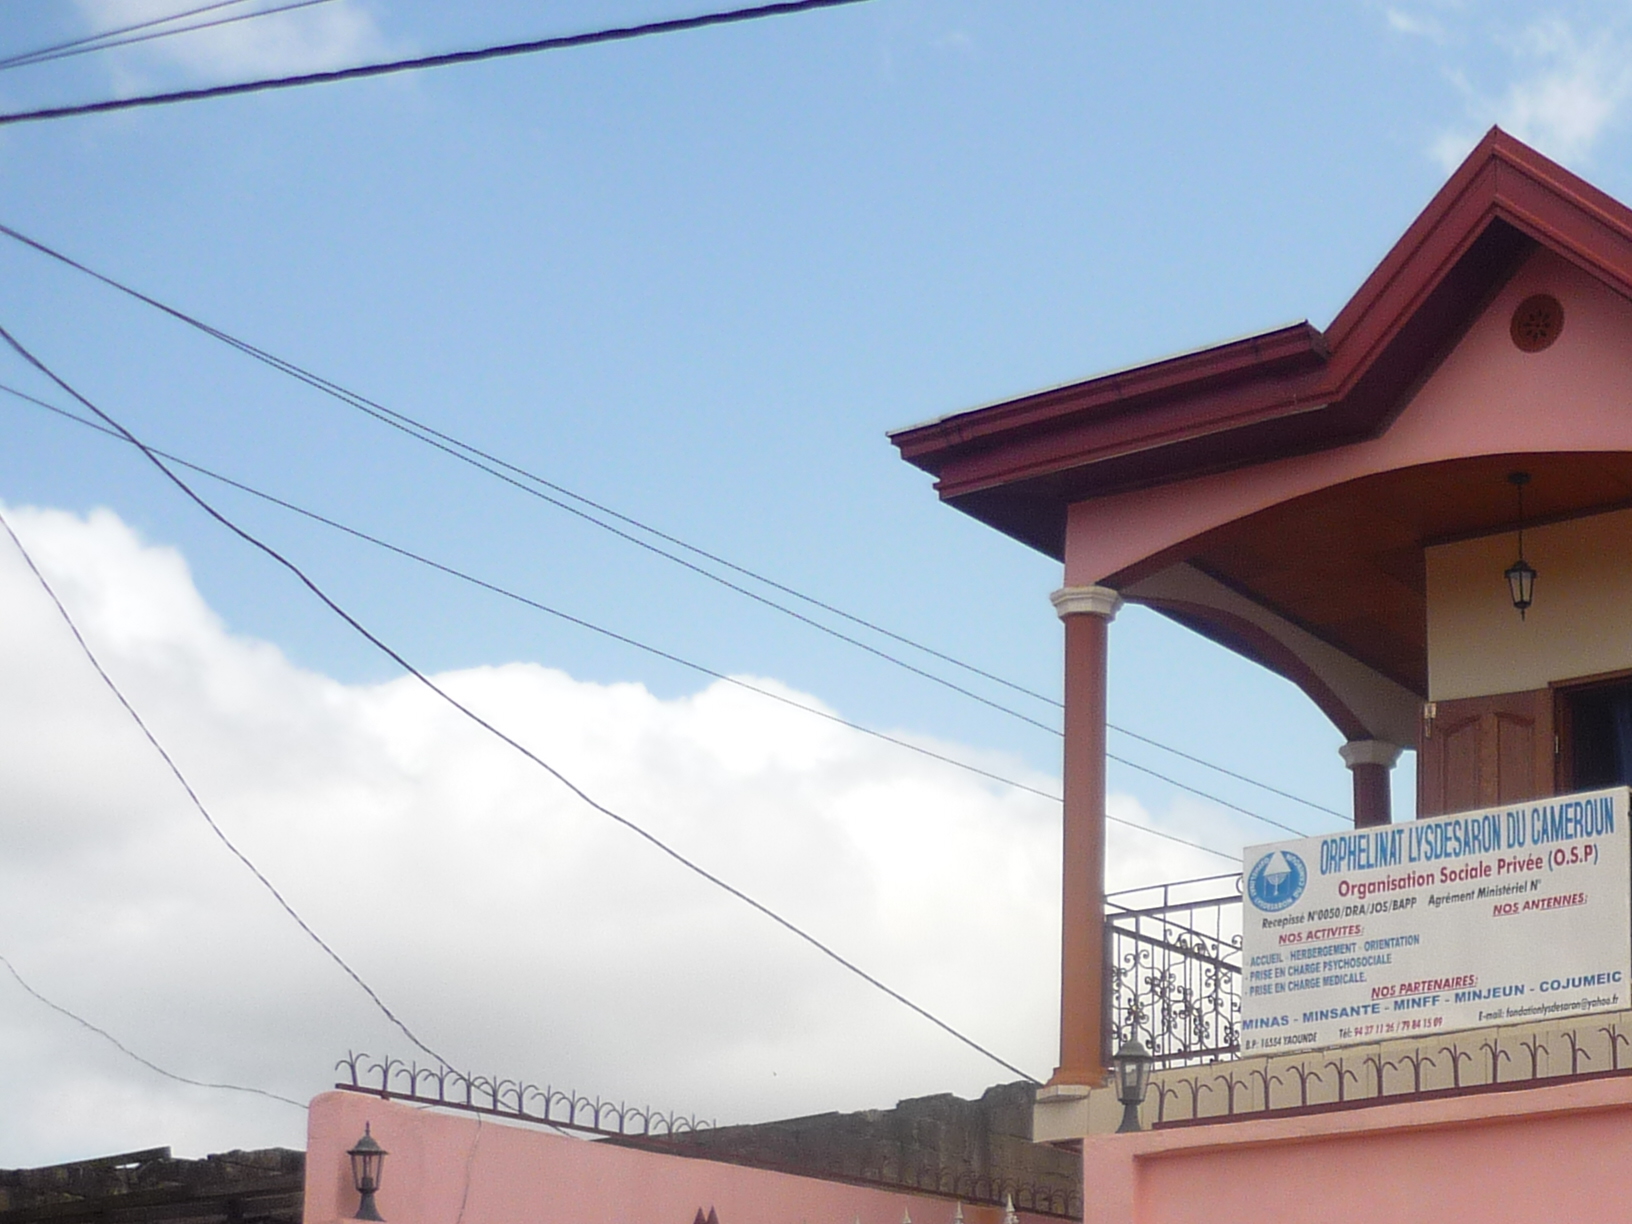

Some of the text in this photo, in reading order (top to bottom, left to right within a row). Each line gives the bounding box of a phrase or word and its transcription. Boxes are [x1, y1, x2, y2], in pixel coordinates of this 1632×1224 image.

[1320, 797, 1614, 875] ORPHELINAT LYSDESARON DU CAMEROUN
[1338, 844, 1599, 899] Organisation Sociale Privée (O.S.P)
[1427, 890, 1475, 907] Agrément
[1477, 881, 1527, 899] Ministériel
[1493, 902, 1520, 916] NOS
[1250, 953, 1283, 967] ACCUEIL
[1364, 934, 1420, 951] ORIENTATION
[1278, 933, 1302, 945] NOS
[1250, 954, 1392, 981] PRISE EN CHARGE PSYCHOSOCIALE
[1250, 984, 1273, 996] PRISE
[1275, 982, 1286, 993] EN
[1288, 978, 1321, 991] CHARGE
[1371, 985, 1396, 999] NOS
[1242, 1015, 1289, 1030] MINAS
[1303, 1003, 1380, 1023] MINSANTE
[1394, 995, 1440, 1011] MINFF
[1455, 984, 1525, 1003] MINJEUN
[1540, 971, 1622, 992] COJUMEIC
